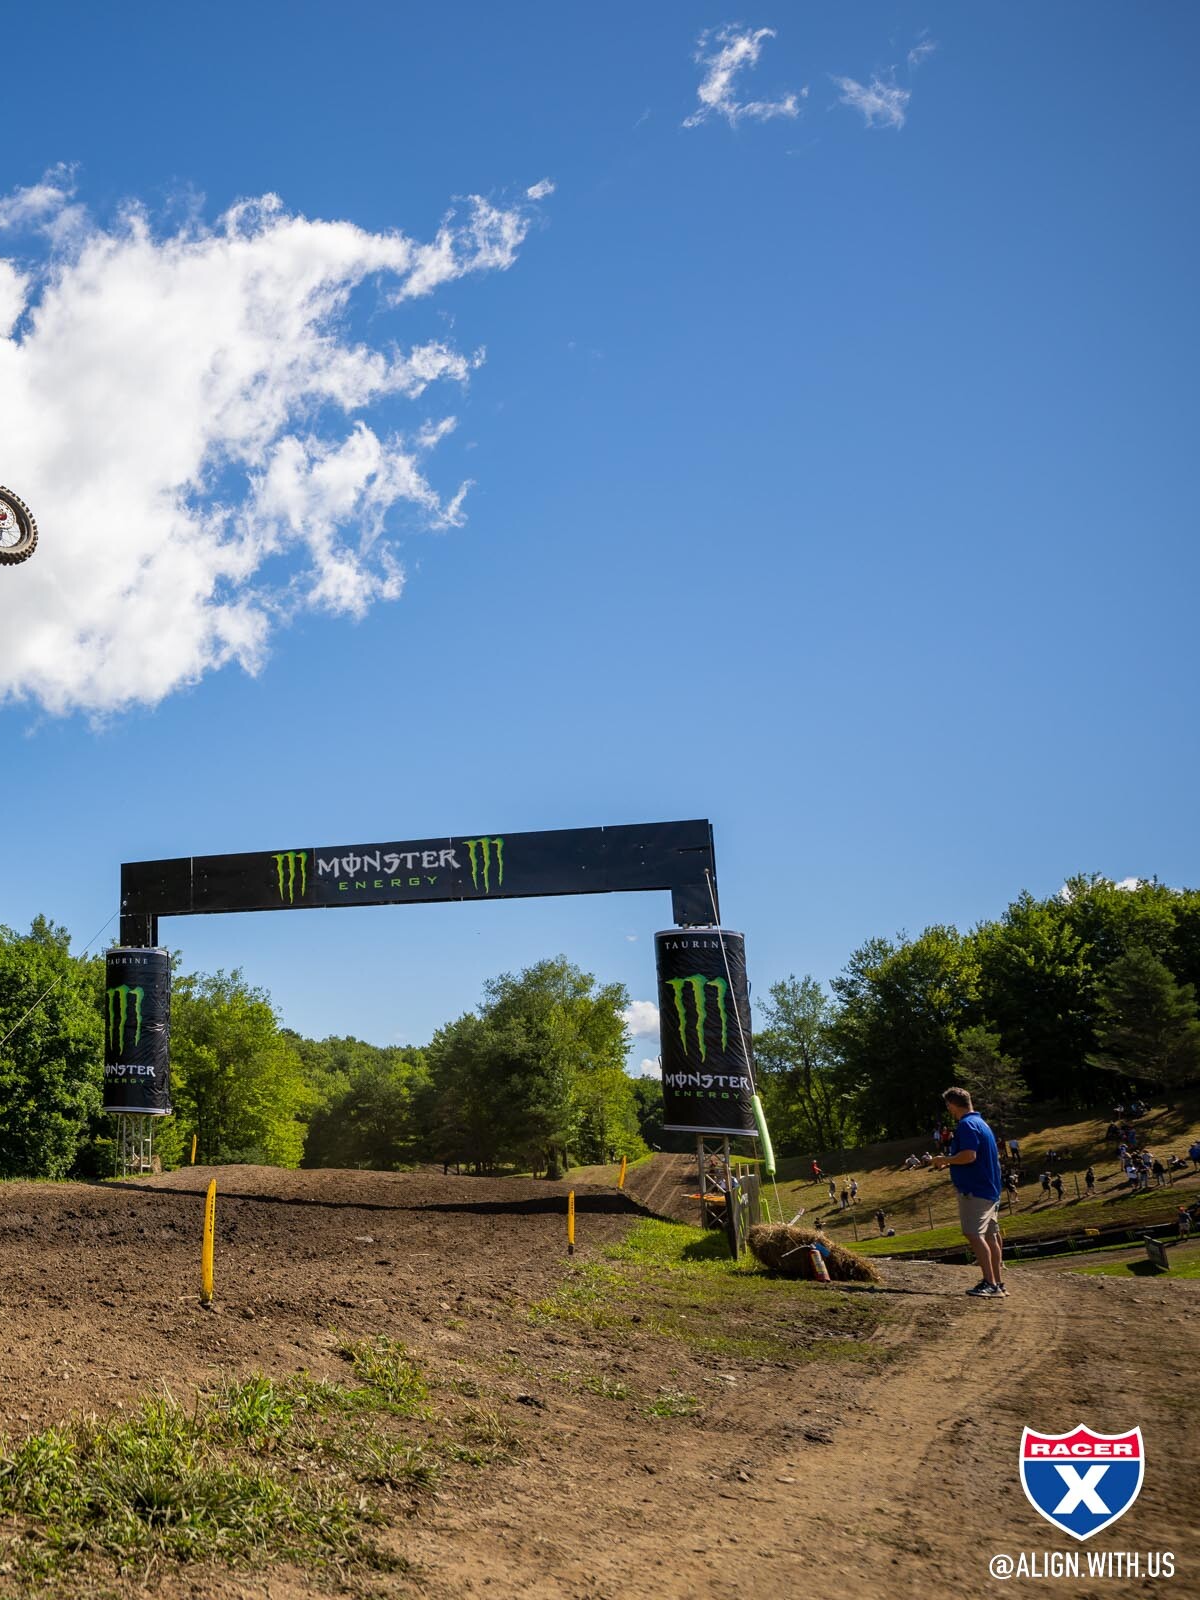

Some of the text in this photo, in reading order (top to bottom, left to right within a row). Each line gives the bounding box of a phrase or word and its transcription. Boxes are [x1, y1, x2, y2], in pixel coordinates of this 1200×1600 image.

[317, 849, 461, 878] MONSTER
[339, 876, 438, 890] ENERGY
[105, 1062, 156, 1077] ONSTER
[665, 1072, 750, 1090] MONSTER
[674, 1090, 740, 1099] ENERGY
